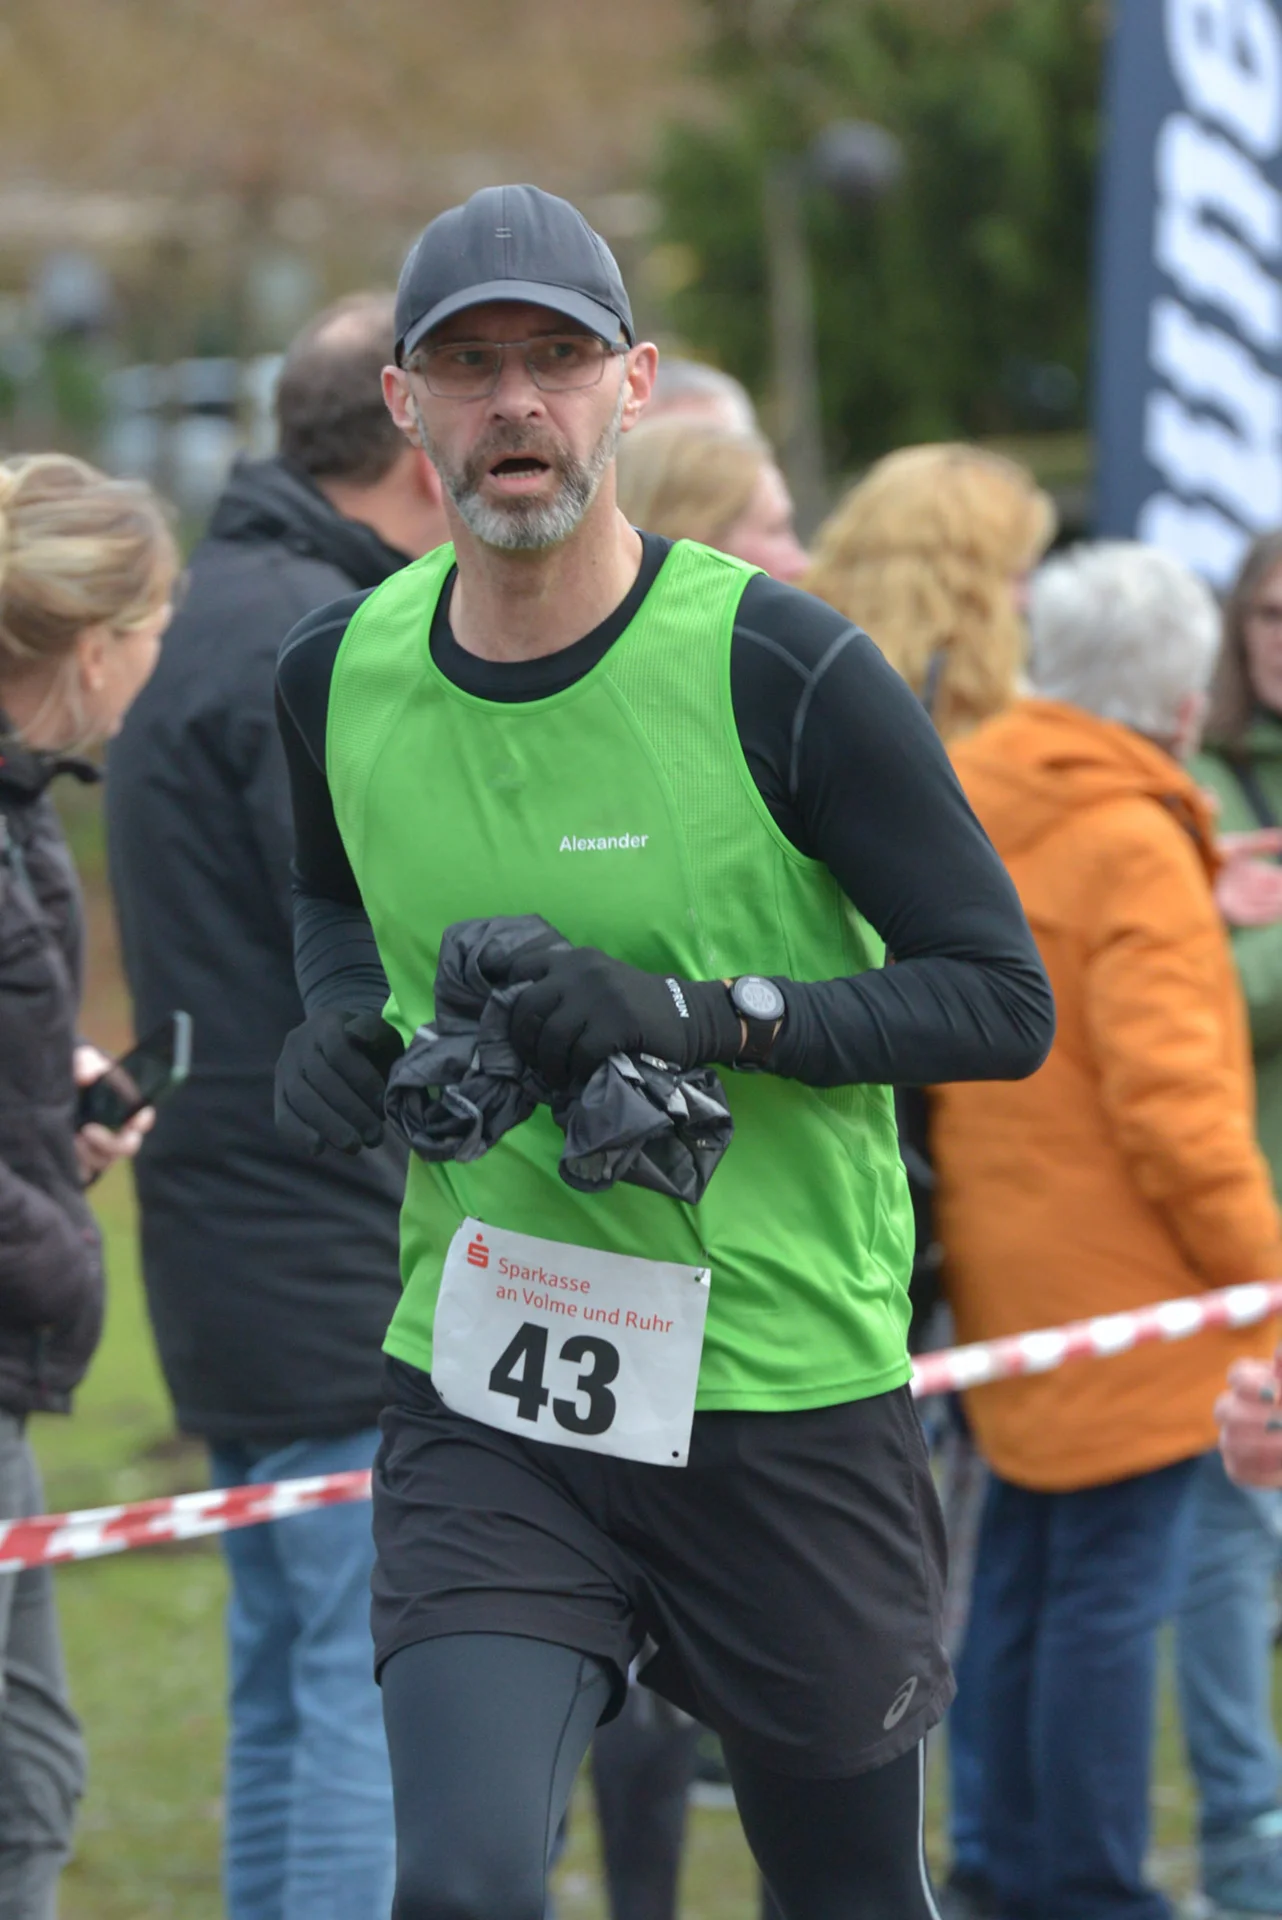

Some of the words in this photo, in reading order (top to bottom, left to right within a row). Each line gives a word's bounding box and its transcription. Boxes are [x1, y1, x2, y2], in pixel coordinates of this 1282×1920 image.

[559, 832, 649, 852] Alexander
[665, 977, 690, 1018] KIPRUN
[498, 1257, 591, 1294] Sparkasse
[496, 1285, 517, 1302] an
[523, 1287, 578, 1317] Volme
[583, 1308, 620, 1325] und
[625, 1311, 674, 1333] Ruhr
[488, 1321, 620, 1436] 43
